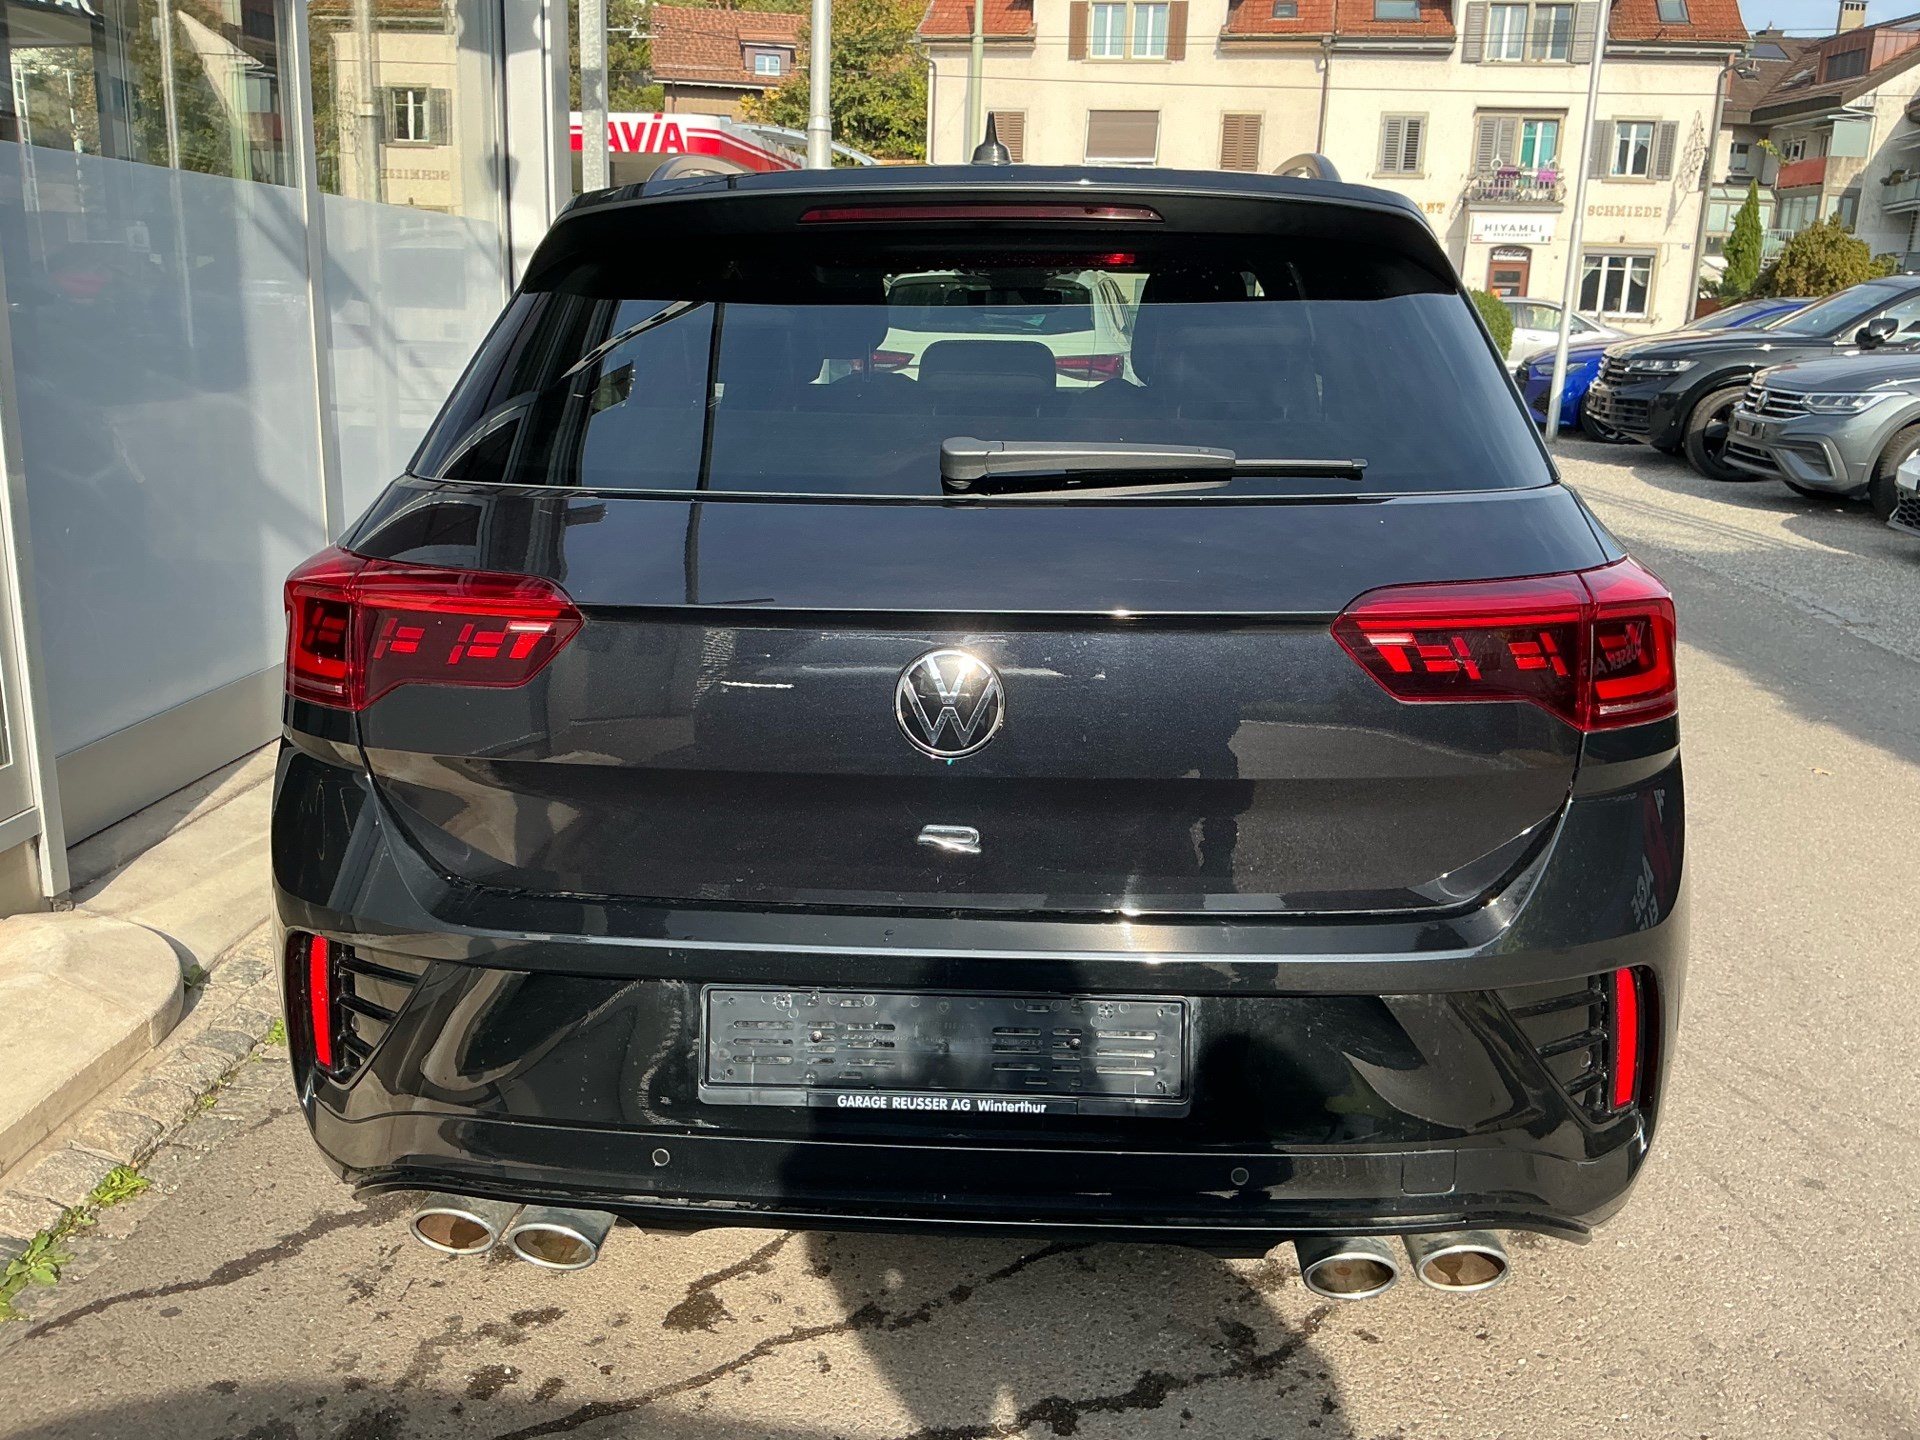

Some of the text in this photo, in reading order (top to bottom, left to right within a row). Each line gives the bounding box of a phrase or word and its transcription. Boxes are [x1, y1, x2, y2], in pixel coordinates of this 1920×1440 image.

[1587, 204, 1662, 218] SCHMIEDE
[1484, 223, 1543, 233] HIYAMLI
[837, 1095, 1047, 1114] GARAGE REUSSER AG Winterthur
